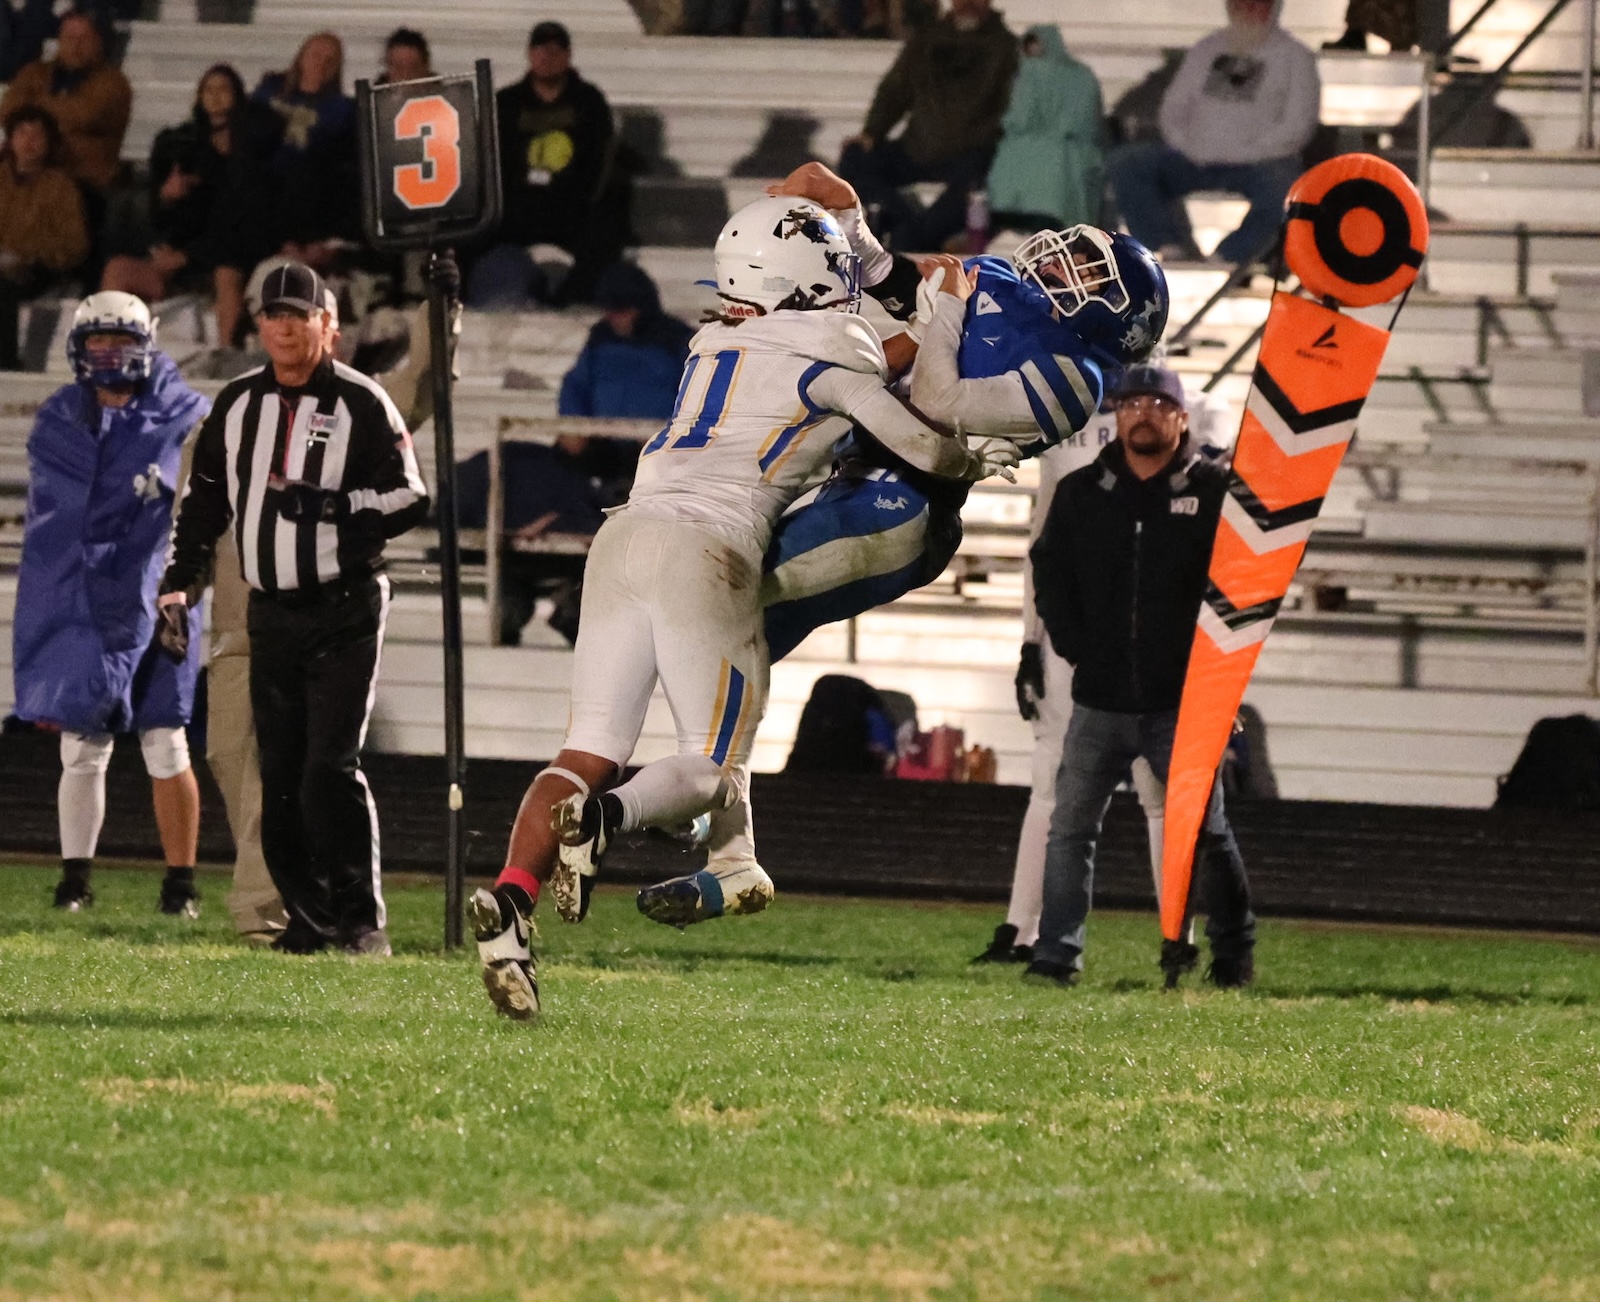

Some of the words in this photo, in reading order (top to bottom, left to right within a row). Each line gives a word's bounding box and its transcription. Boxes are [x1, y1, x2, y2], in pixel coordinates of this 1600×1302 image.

[393, 95, 461, 210] 3
[641, 347, 746, 459] 11
[1059, 431, 1087, 448] HE
